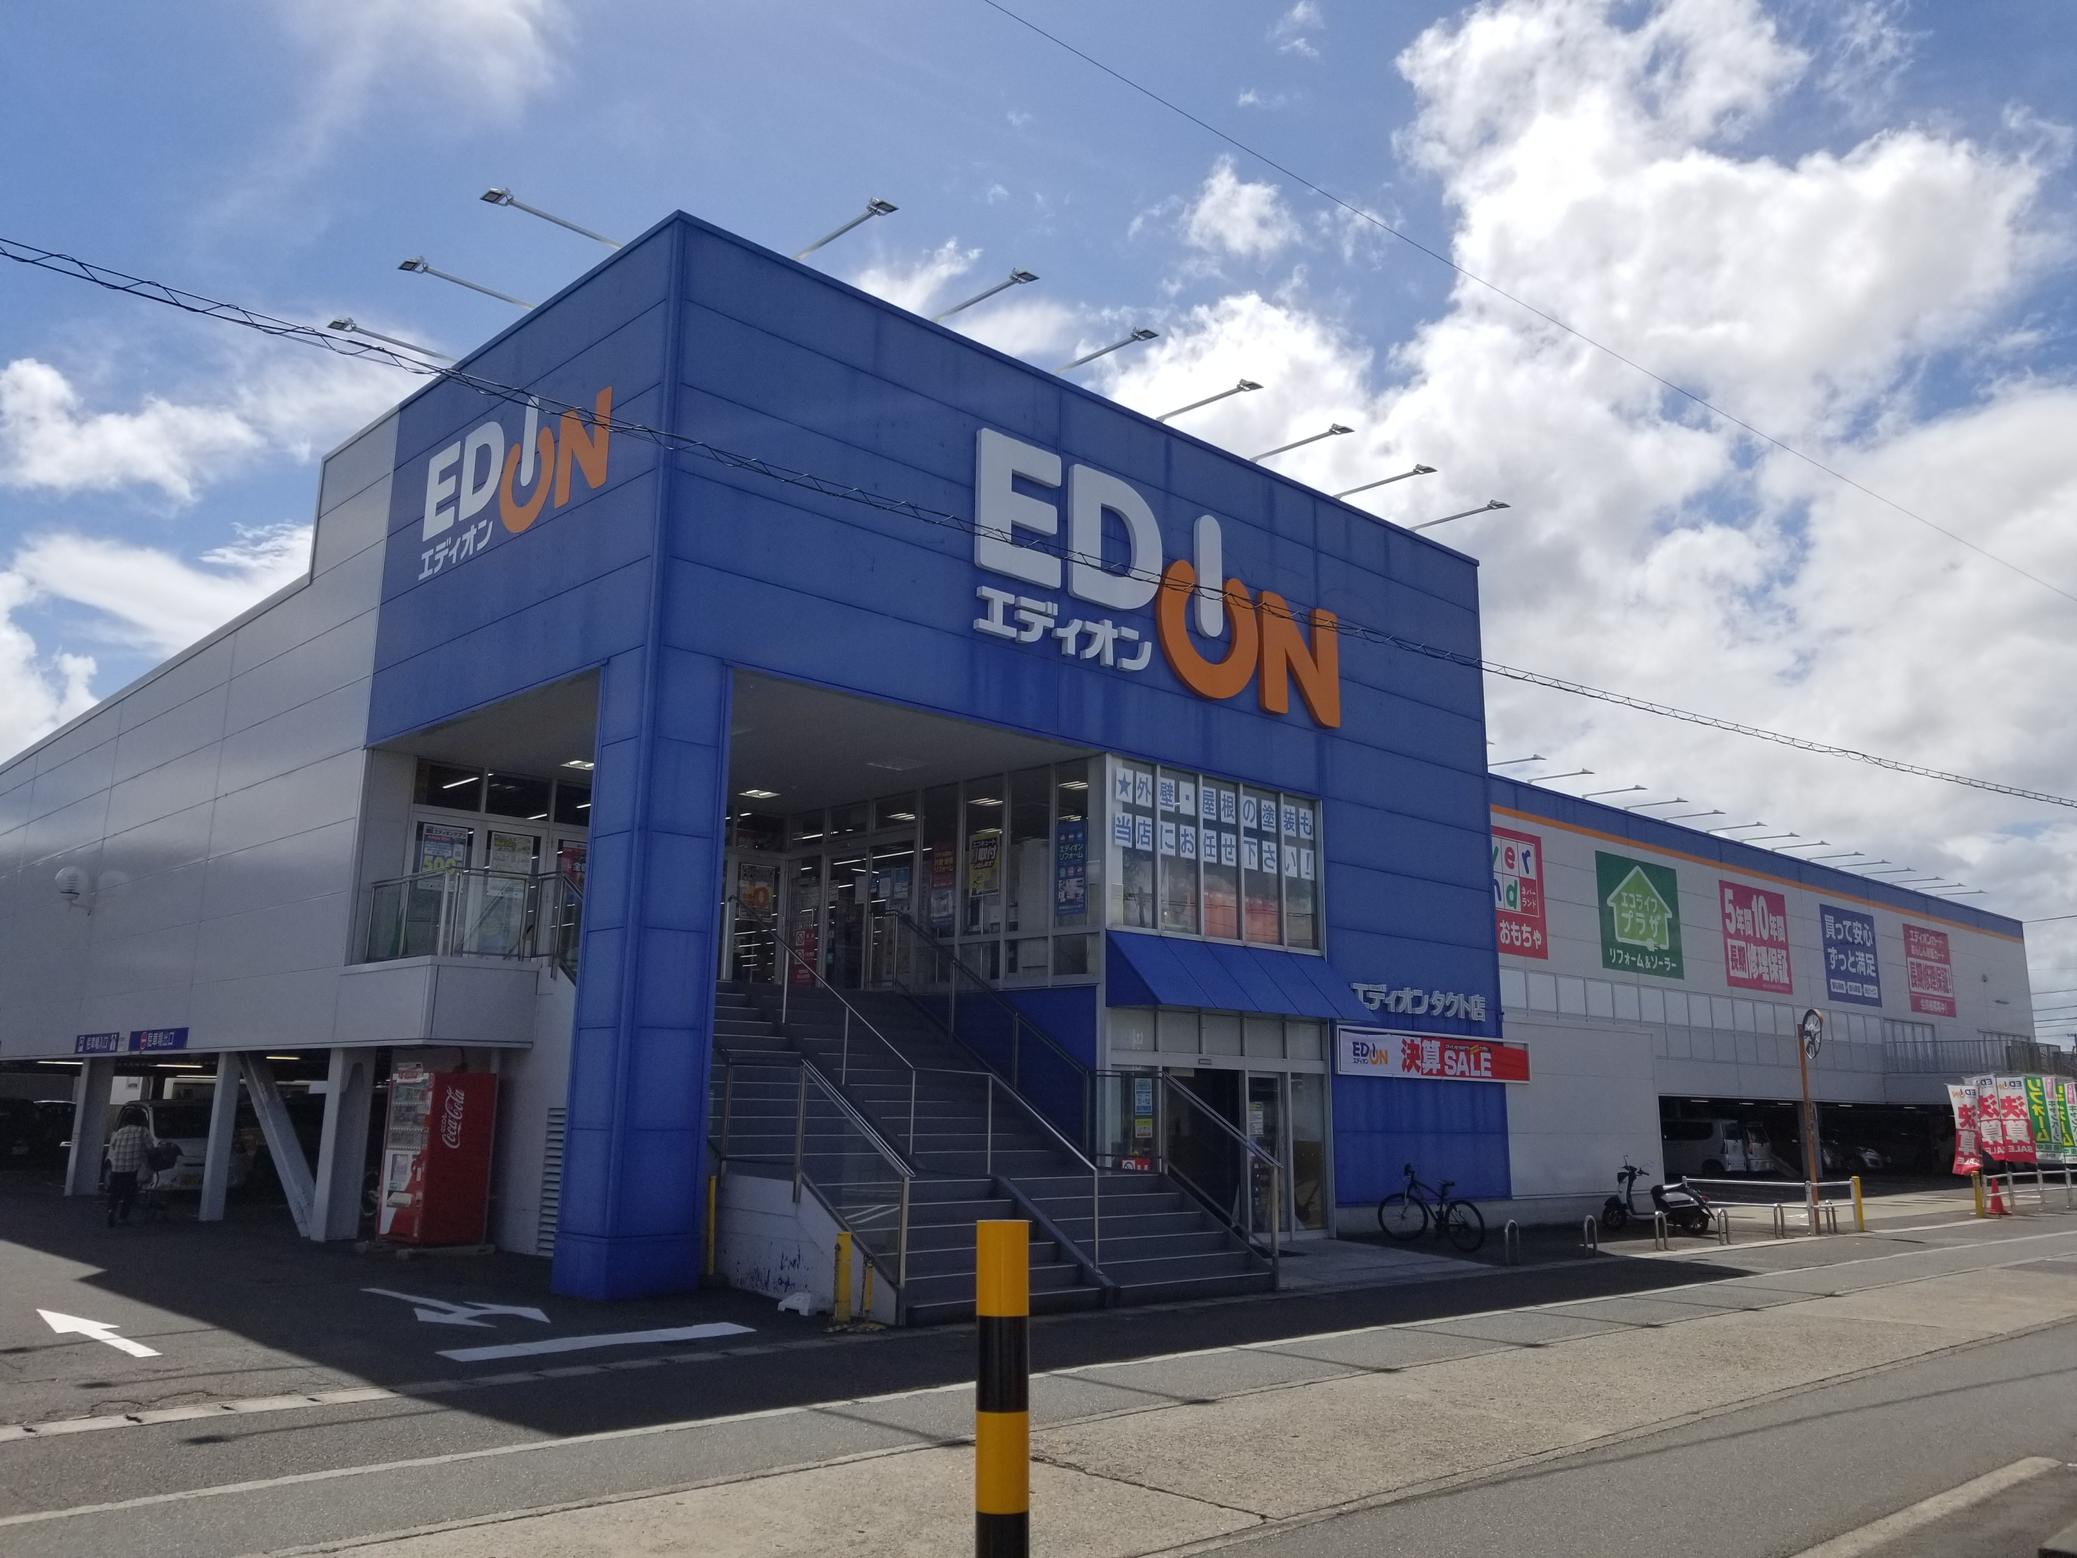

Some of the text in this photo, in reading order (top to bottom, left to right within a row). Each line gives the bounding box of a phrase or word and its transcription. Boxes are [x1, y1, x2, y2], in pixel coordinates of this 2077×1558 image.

[422, 385, 613, 534] EDION
[418, 520, 493, 581] エディオン
[974, 427, 1341, 728] EDION
[973, 586, 1152, 671] エディオン
[1620, 891, 1659, 912] エコライフ
[1500, 919, 1542, 950] おもちゃ
[1620, 910, 1661, 938] プラザ
[1823, 914, 1874, 948] 買って安心
[1827, 947, 1877, 977] ずっと満足
[1352, 1041, 1388, 1065] EDION
[1444, 1049, 1493, 1077] SALE
